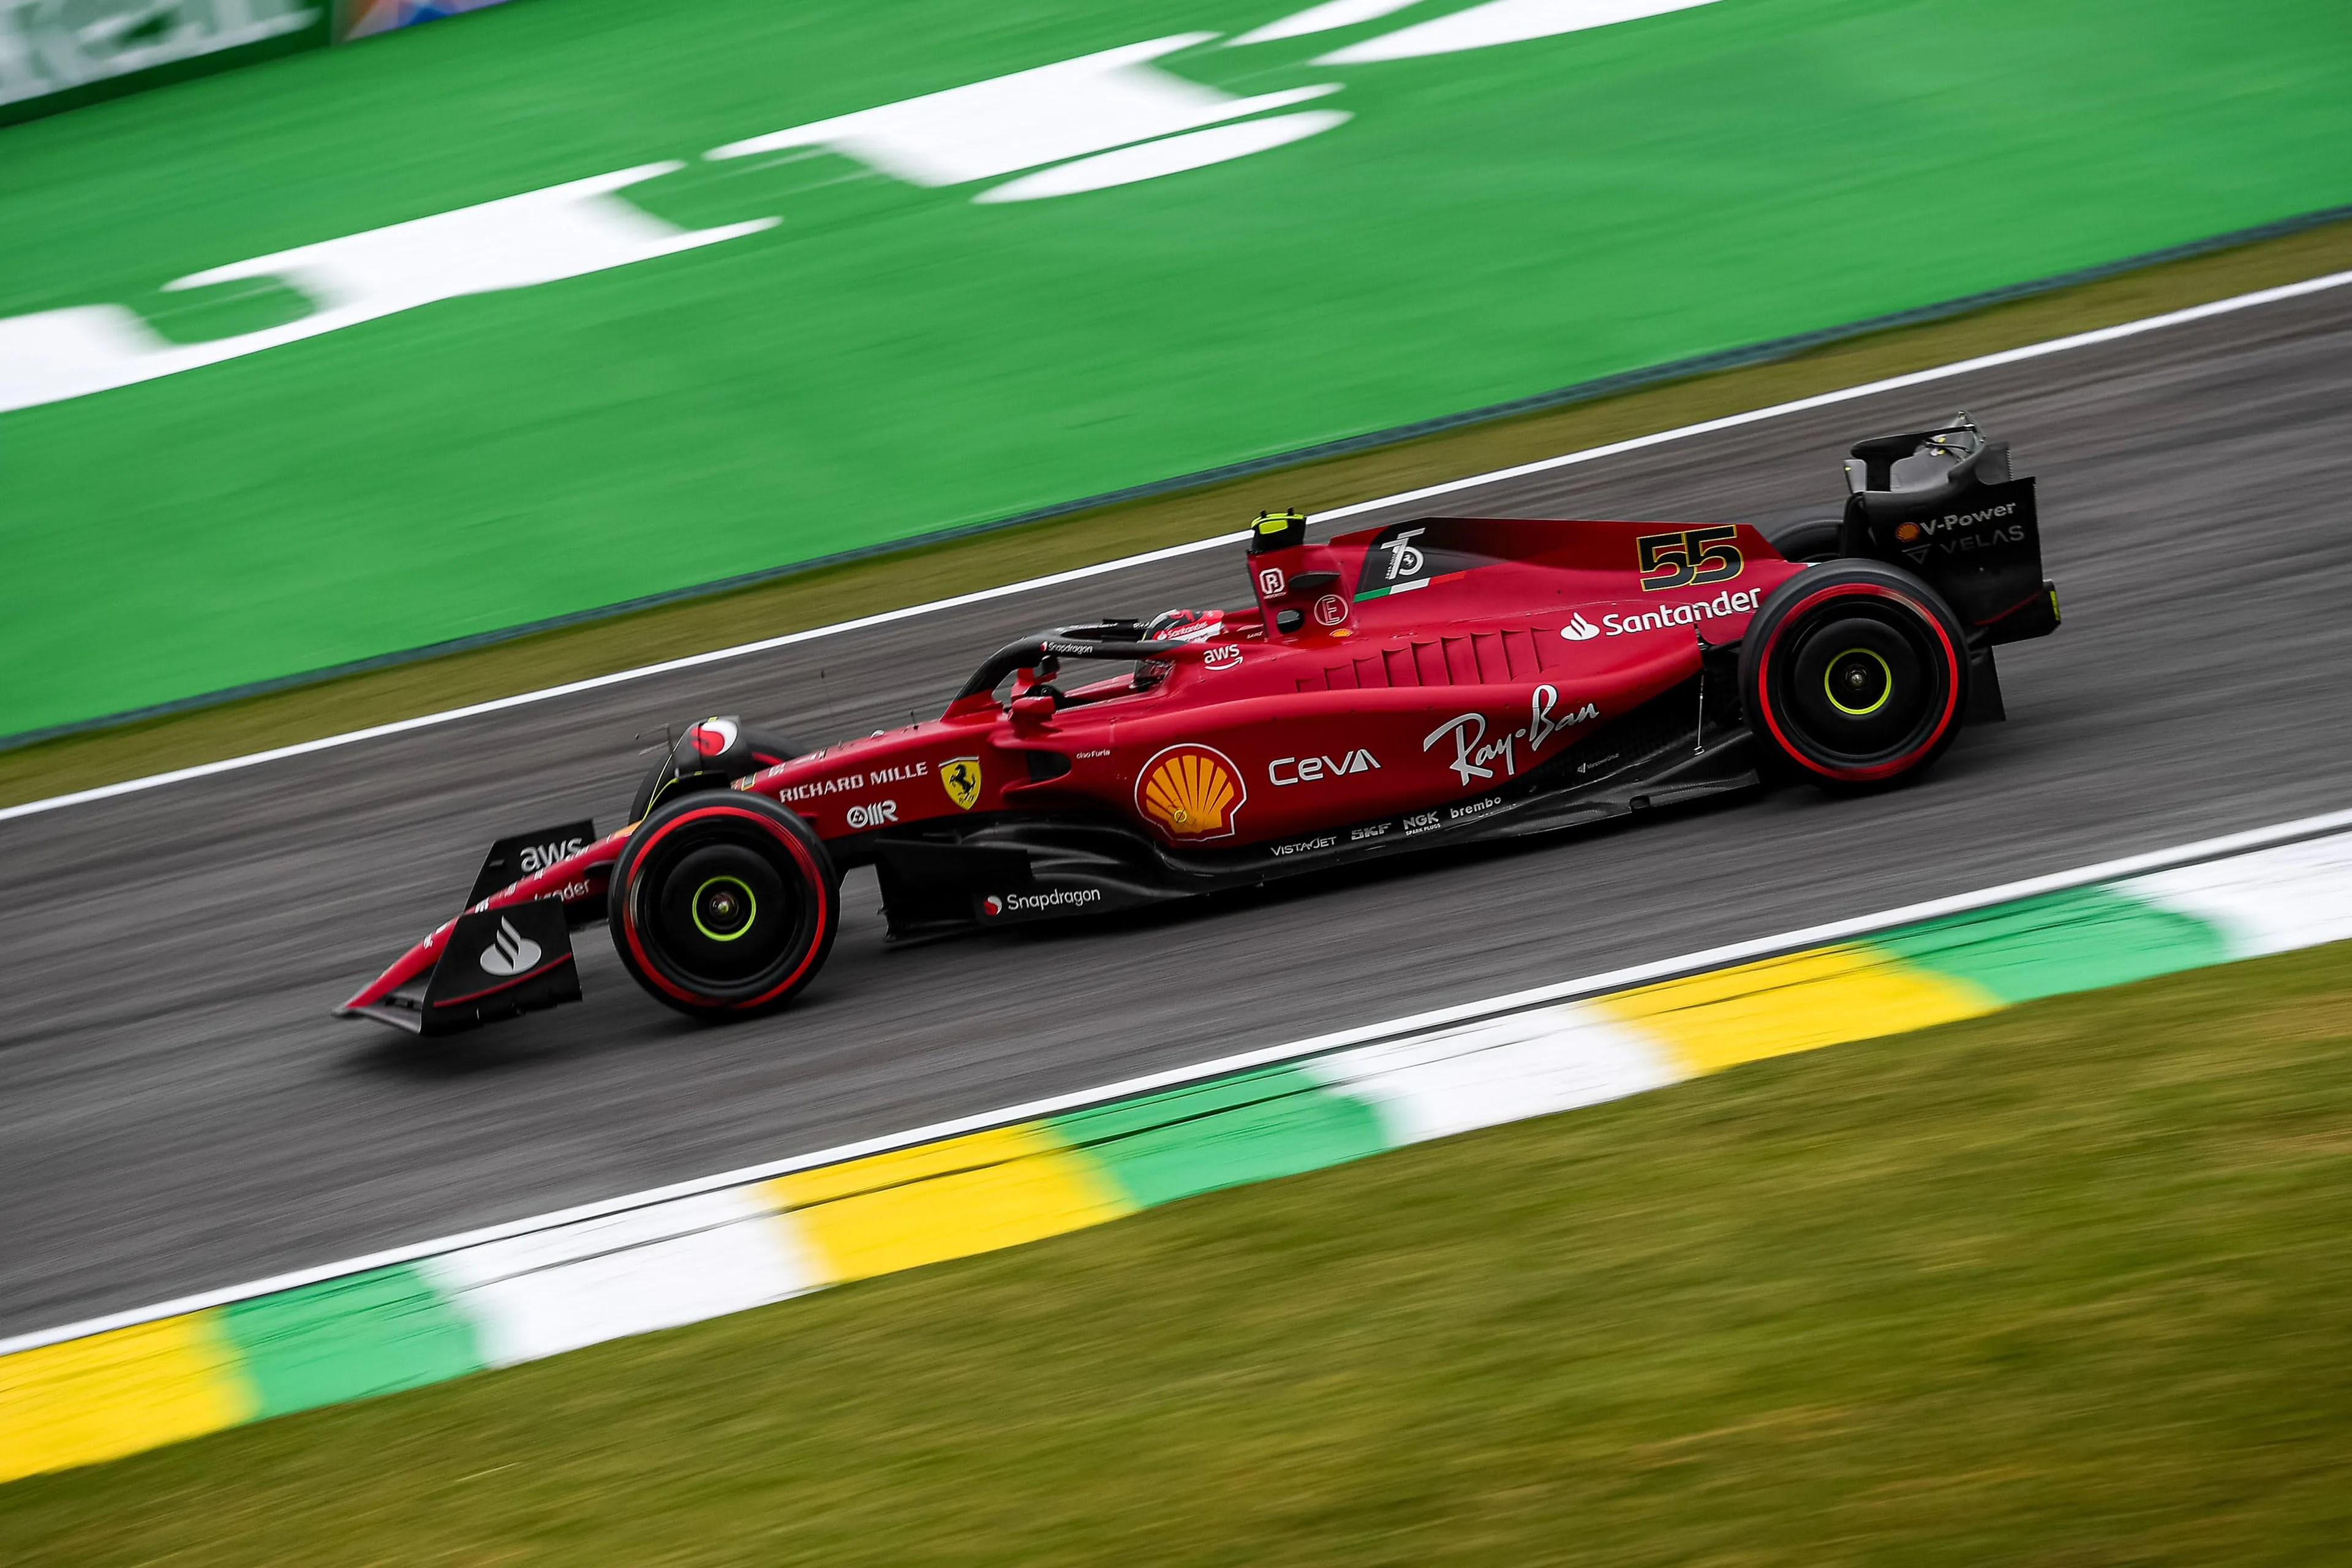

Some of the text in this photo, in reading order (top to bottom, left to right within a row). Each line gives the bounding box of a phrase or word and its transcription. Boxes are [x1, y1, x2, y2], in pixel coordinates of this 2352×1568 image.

[1920, 502, 2016, 535] V-Power
[1636, 524, 1744, 592] 55
[1602, 587, 1762, 636] Santander
[1167, 621, 1208, 638] Santander
[1048, 641, 1093, 655] Snapdragon
[1204, 644, 1240, 664] aws
[779, 761, 929, 803] RICHARD MILLE
[1450, 797, 1501, 818] brembo
[1403, 811, 1439, 830] NGK
[1406, 823, 1441, 836] SPARK PLUGS
[1351, 823, 1392, 840] SKF
[1007, 888, 1101, 911] Snapdragon
